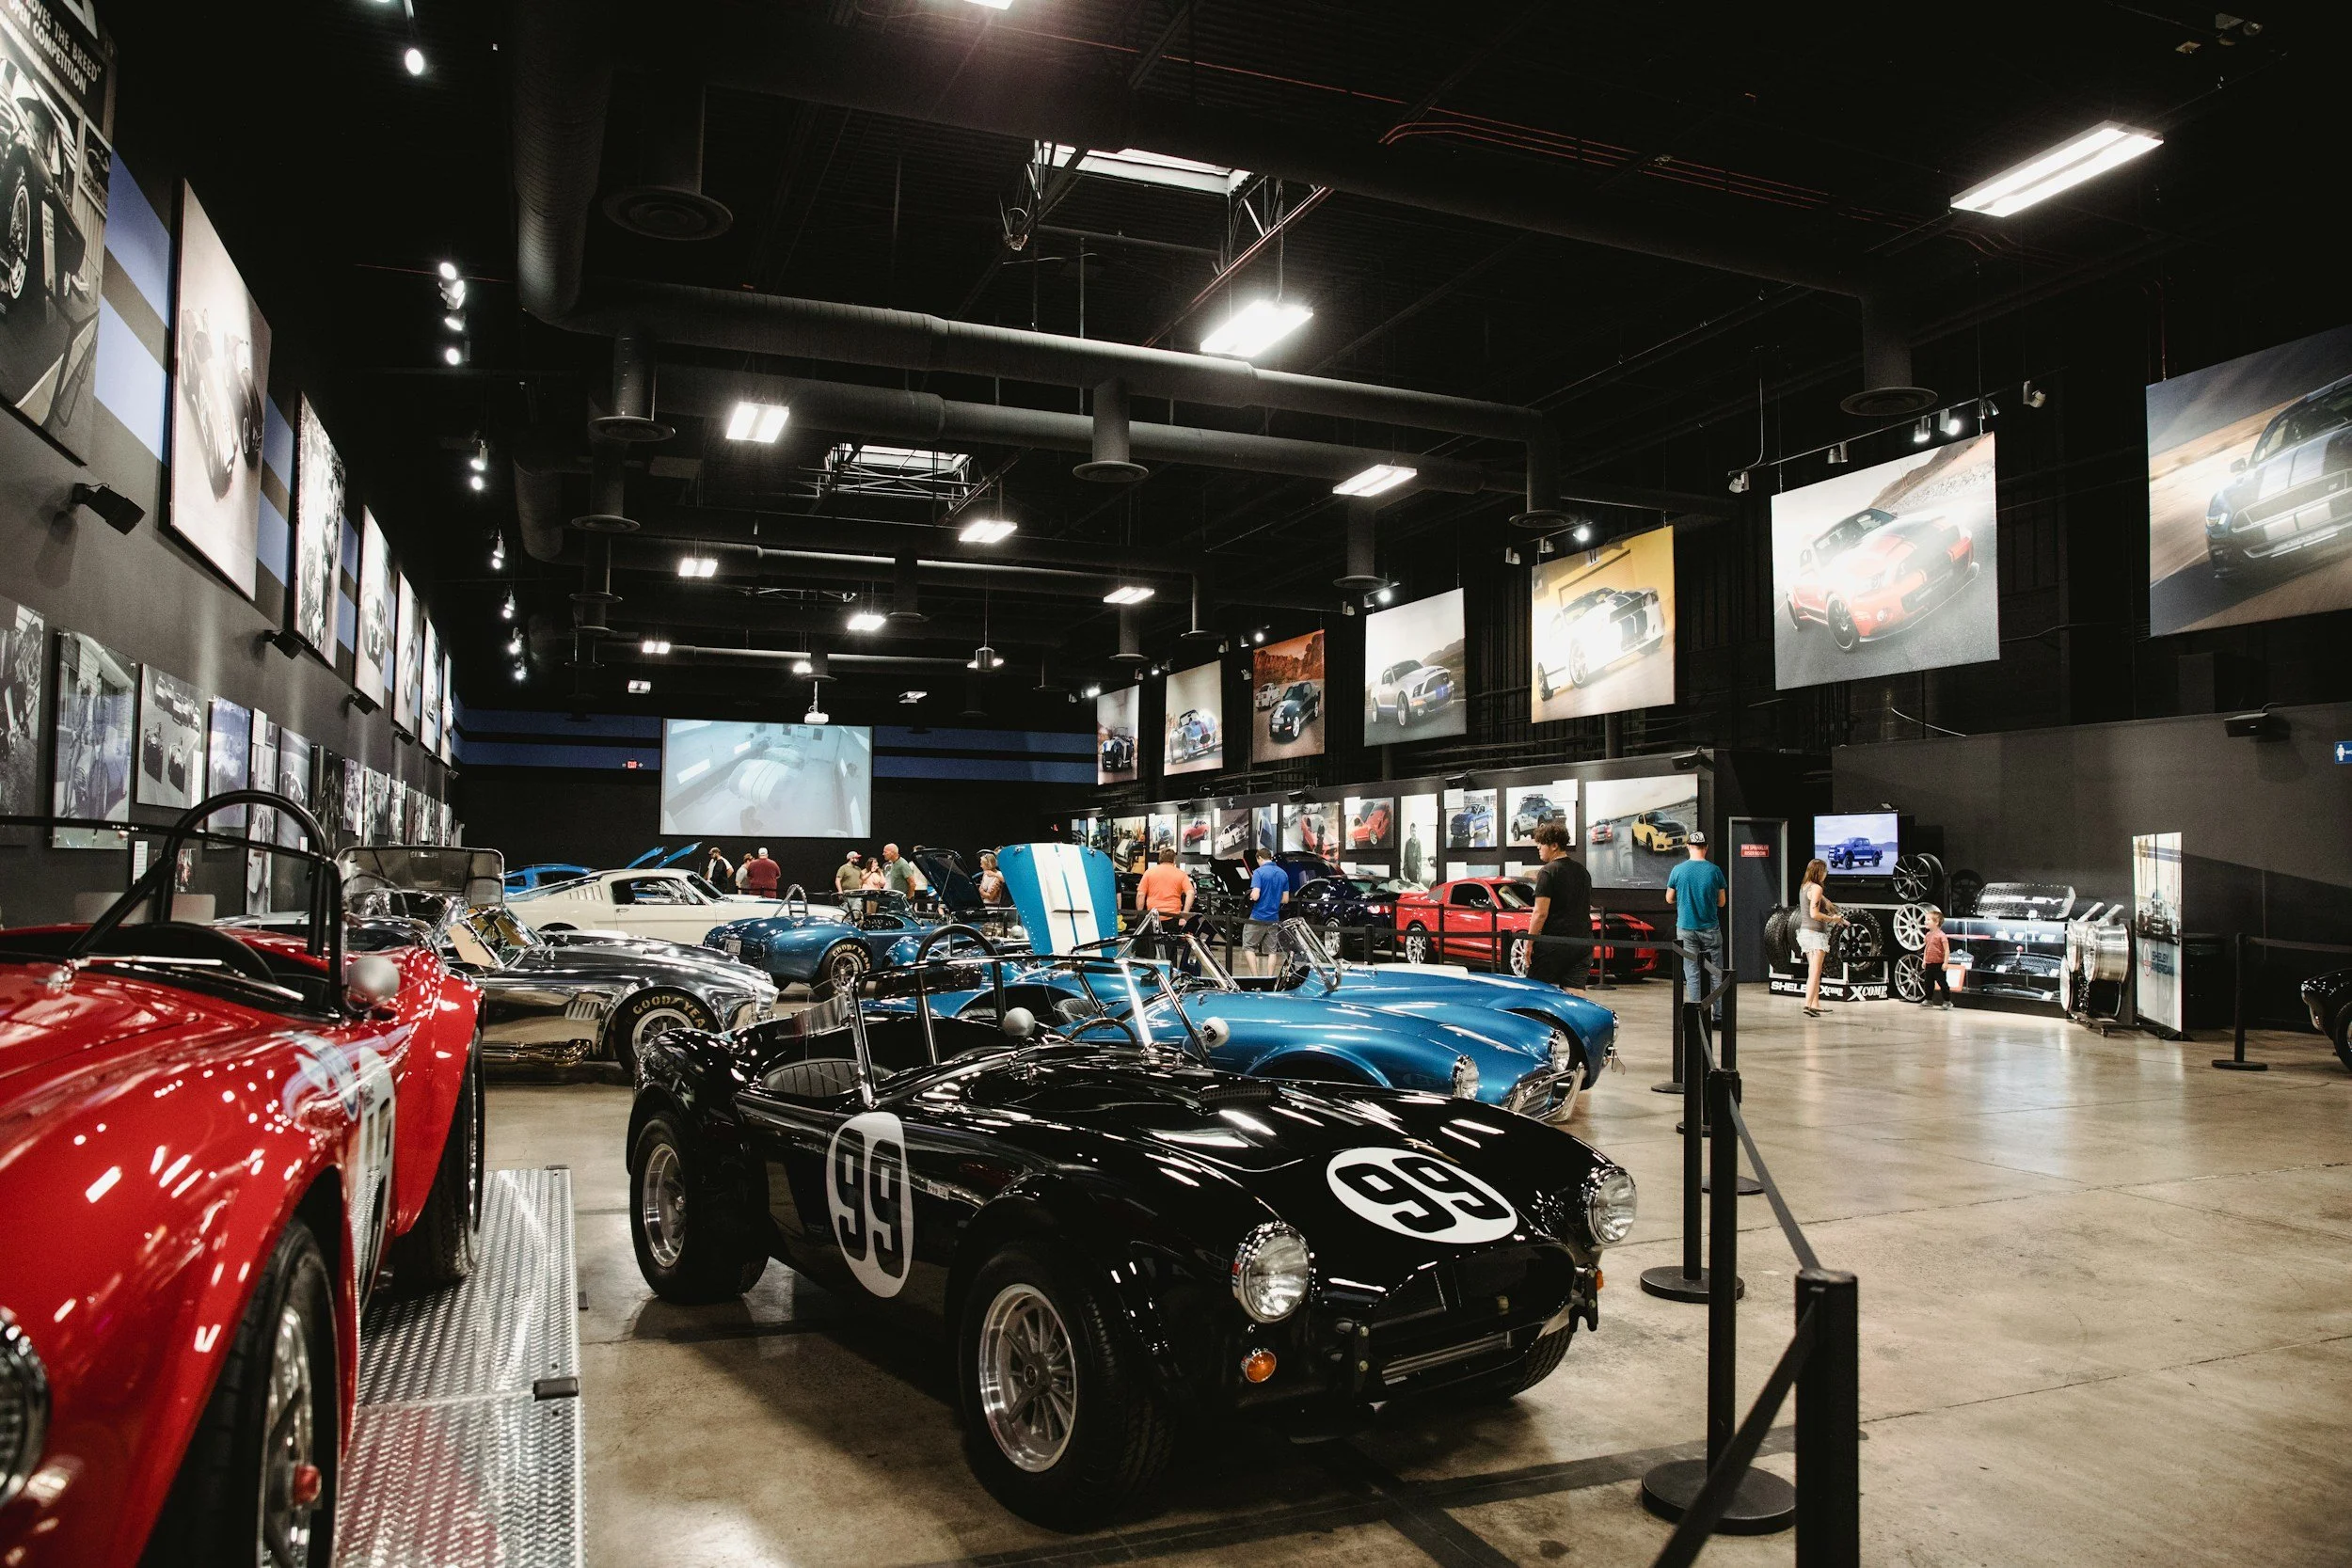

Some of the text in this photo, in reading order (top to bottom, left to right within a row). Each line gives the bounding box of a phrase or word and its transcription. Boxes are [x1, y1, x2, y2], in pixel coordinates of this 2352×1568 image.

[33, 21, 87, 95] COMPETITION
[55, 21, 70, 51] THE
[835, 1127, 904, 1279] 99
[1334, 1157, 1511, 1234] 99
